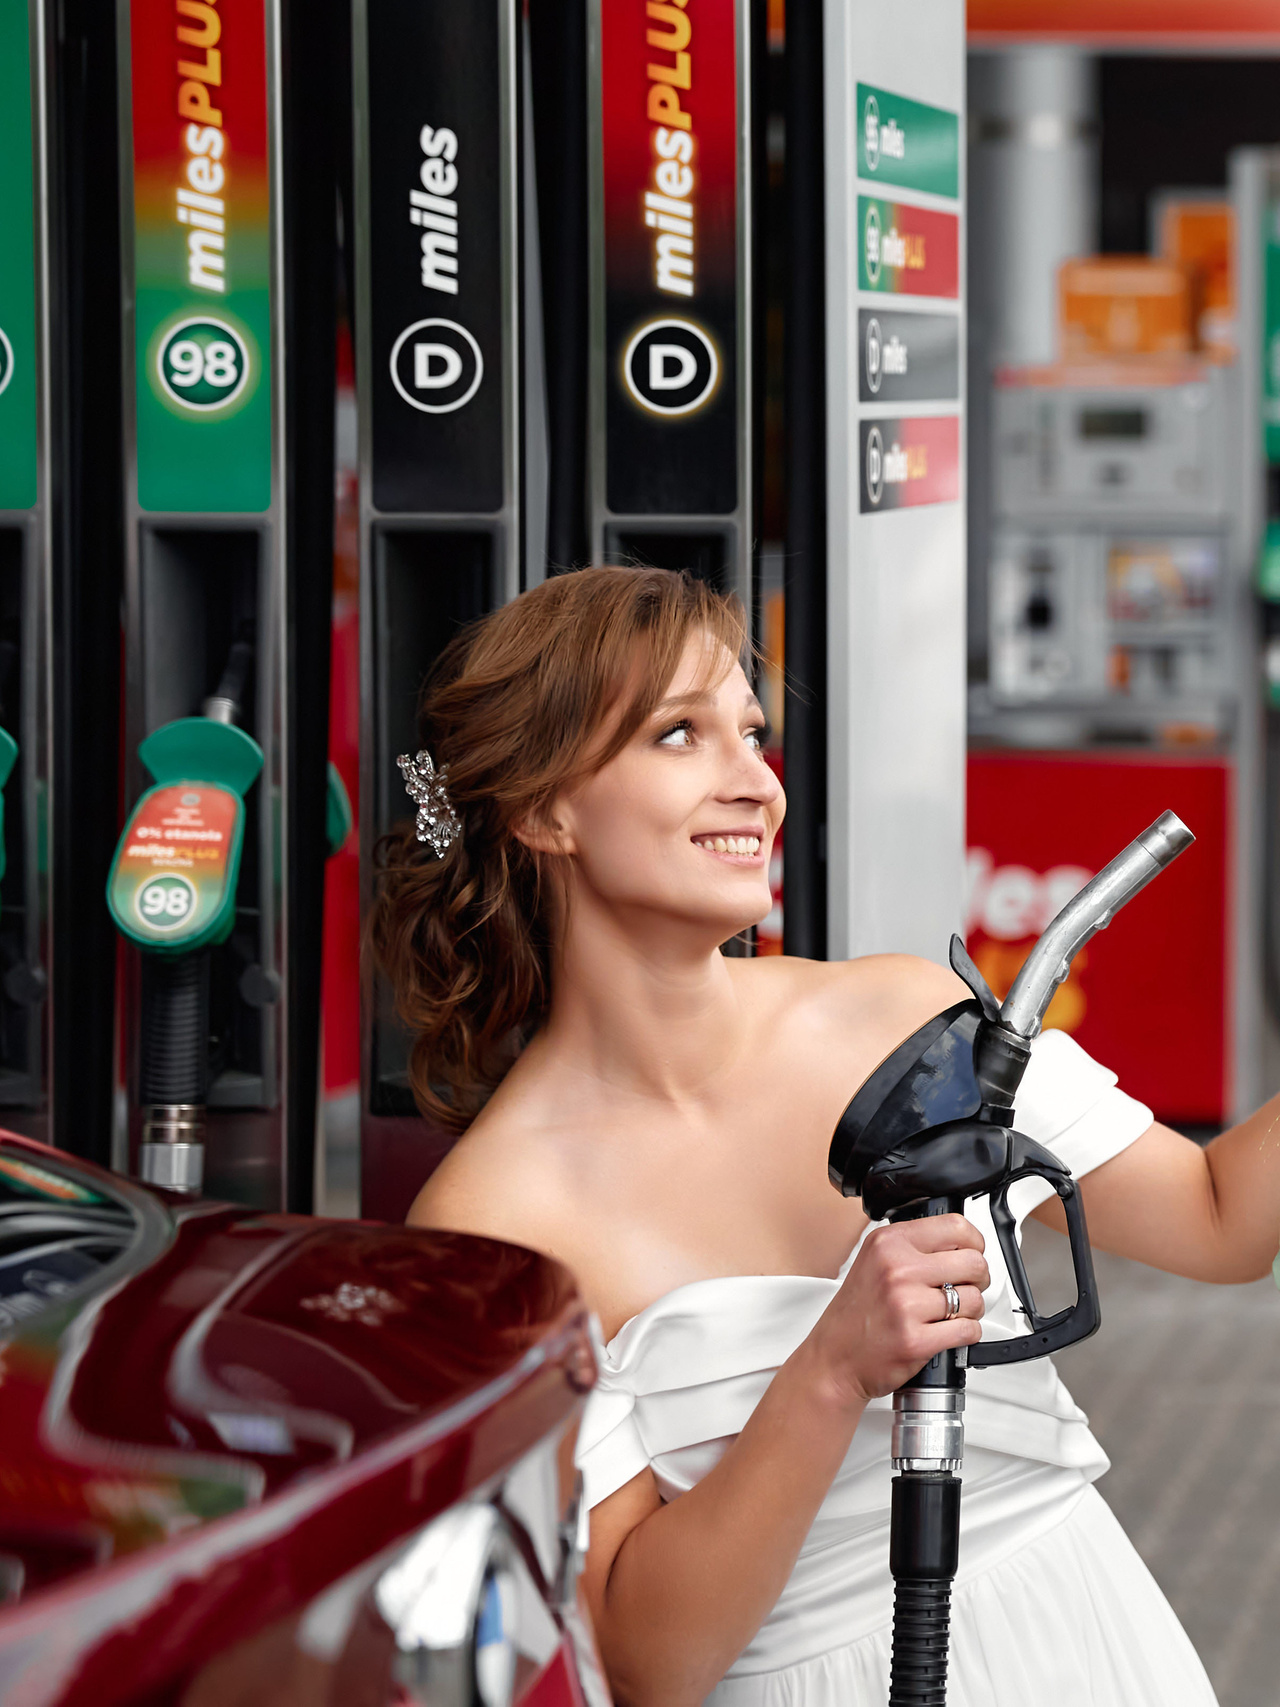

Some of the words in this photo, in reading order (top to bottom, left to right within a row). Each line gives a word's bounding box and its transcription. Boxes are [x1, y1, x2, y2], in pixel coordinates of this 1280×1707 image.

[176, 0, 225, 293] milesPLU
[645, 0, 693, 296] milesPLU
[409, 123, 458, 296] miles
[168, 340, 238, 388] 98
[414, 343, 462, 389] D
[649, 344, 697, 390] D
[143, 885, 190, 917] 98
